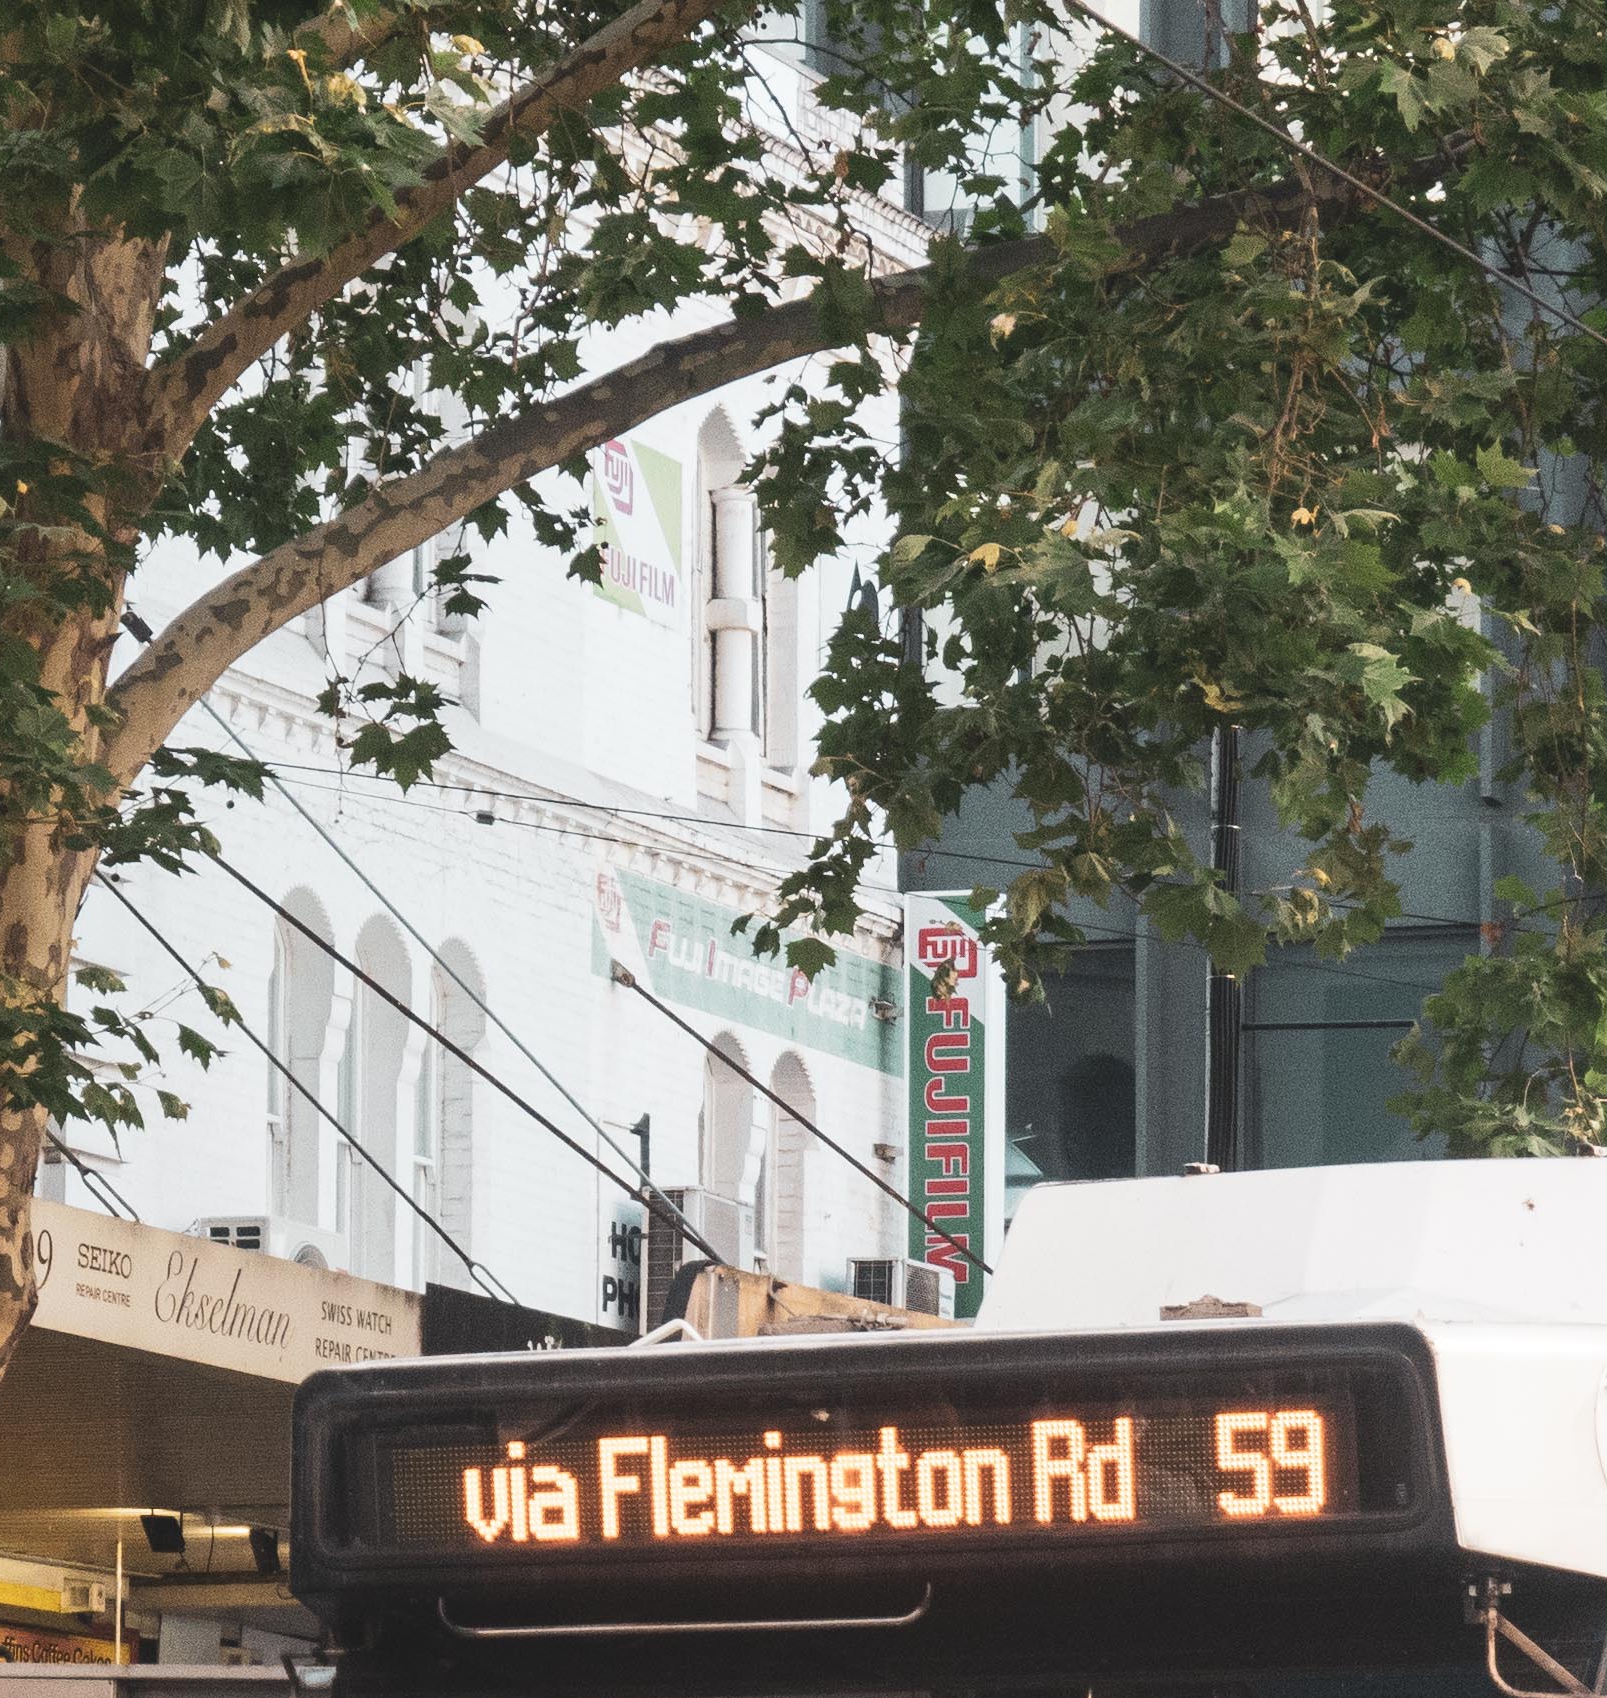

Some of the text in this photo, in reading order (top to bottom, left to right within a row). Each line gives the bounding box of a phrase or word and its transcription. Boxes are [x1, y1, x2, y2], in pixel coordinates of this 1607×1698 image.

[924, 996, 971, 1284] FUJIFILM
[77, 1243, 133, 1279] SEIKO
[75, 1282, 131, 1308] REPAIR CENTRE
[154, 1249, 291, 1350] Ekselman
[321, 1300, 393, 1336] SWISS WATCH
[315, 1337, 352, 1364] REPAIR
[463, 1408, 1327, 1543] via Flemington Rd 59
